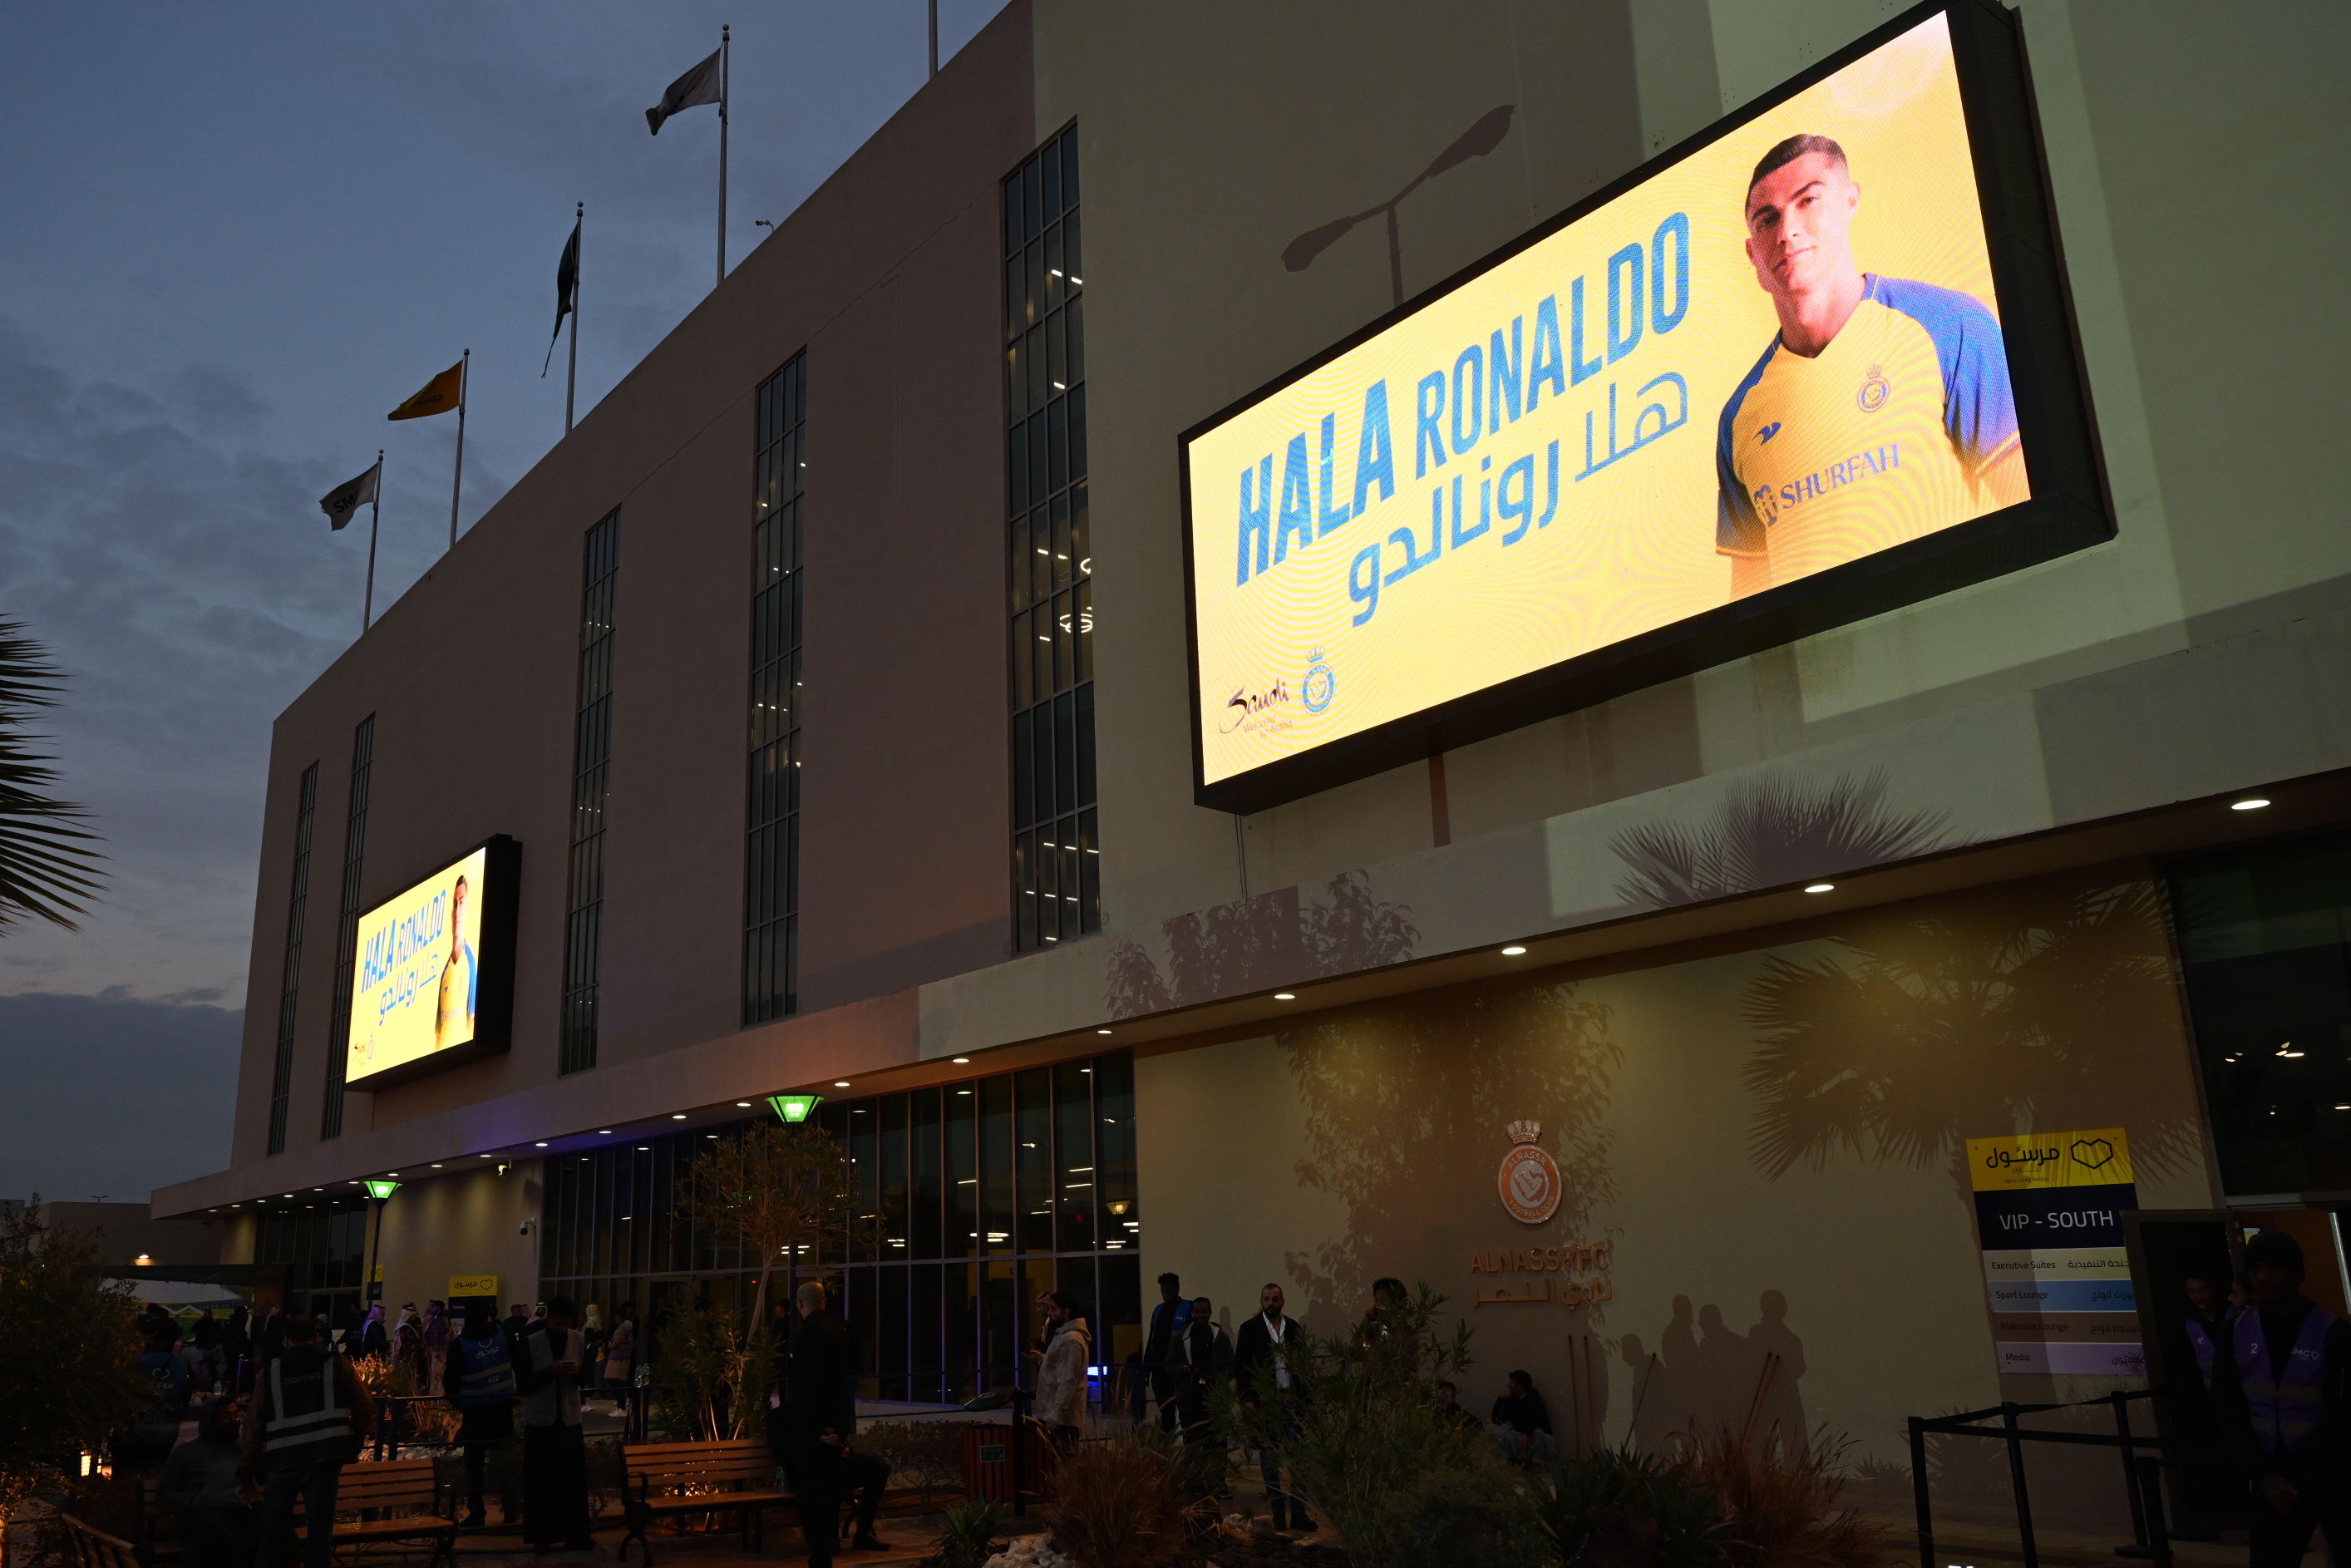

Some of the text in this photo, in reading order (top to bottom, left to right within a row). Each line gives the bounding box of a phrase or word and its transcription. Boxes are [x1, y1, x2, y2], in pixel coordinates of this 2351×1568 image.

[1236, 211, 1689, 588] HALA RONALDO
[1780, 443, 1900, 510] SHURFAH
[1348, 372, 1688, 629] هلا رونالدو
[1219, 678, 1289, 734] Saudi
[362, 889, 446, 994] HALA RONALDO
[1507, 1151, 1547, 1170] ALNASSR
[1509, 1195, 1555, 1217] FOOTBALL CLUB
[1999, 1213, 2029, 1230] VIP
[2047, 1211, 2114, 1230] SOUTH
[1991, 1260, 2057, 1270] Executive Suites
[1473, 1277, 1613, 1311] نادي النصر
[1995, 1290, 2048, 1300] Sport Lounge
[2113, 1291, 2135, 1301] بورت
[2000, 1322, 2068, 1333] Platinum Lounge
[2005, 1353, 2031, 1362] Media
[2250, 1343, 2259, 1354] 2
[2111, 1355, 2146, 1365] علاميون
[487, 1375, 500, 1384] 932
